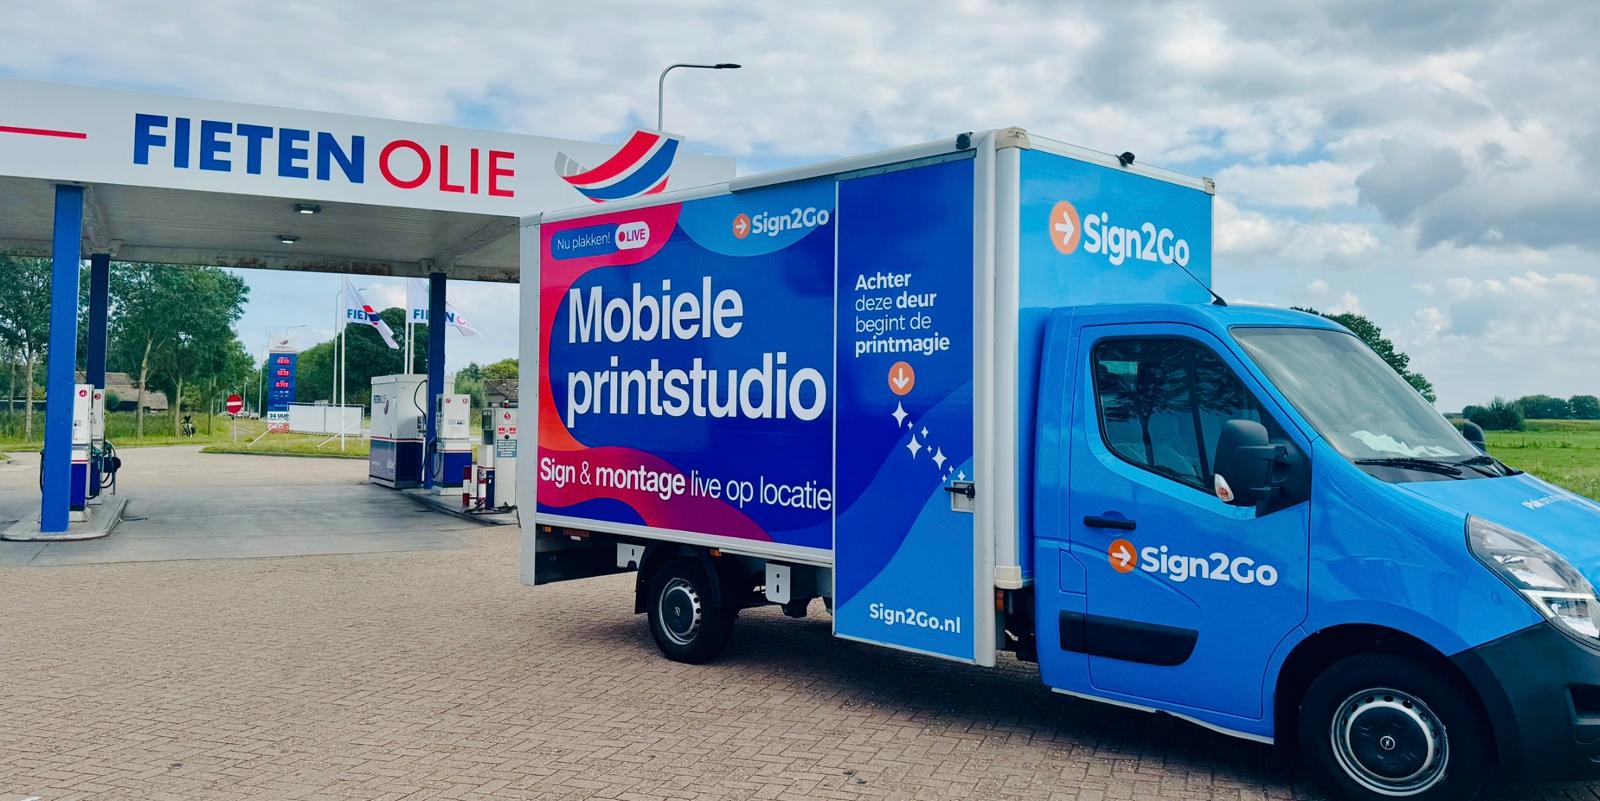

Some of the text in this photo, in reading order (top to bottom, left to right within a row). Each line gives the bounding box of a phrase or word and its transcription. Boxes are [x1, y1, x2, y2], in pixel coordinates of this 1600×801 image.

[133, 113, 515, 198] FIETEN OLIE
[626, 228, 646, 242] LIVE
[752, 207, 830, 237] Sign2Go
[557, 232, 611, 251] Nu plakken!
[1083, 211, 1190, 267] Sign2Go
[854, 271, 912, 291] Achter
[568, 275, 744, 344] Mobiele
[855, 290, 938, 312] deze deur
[855, 311, 932, 336] begint de
[855, 331, 951, 358] printmagie
[567, 351, 827, 428] printstudio
[540, 456, 832, 511] Sign & montage live op locatie
[1140, 544, 1279, 587] Sign2Go
[869, 602, 961, 634] Sign2Go.nl
